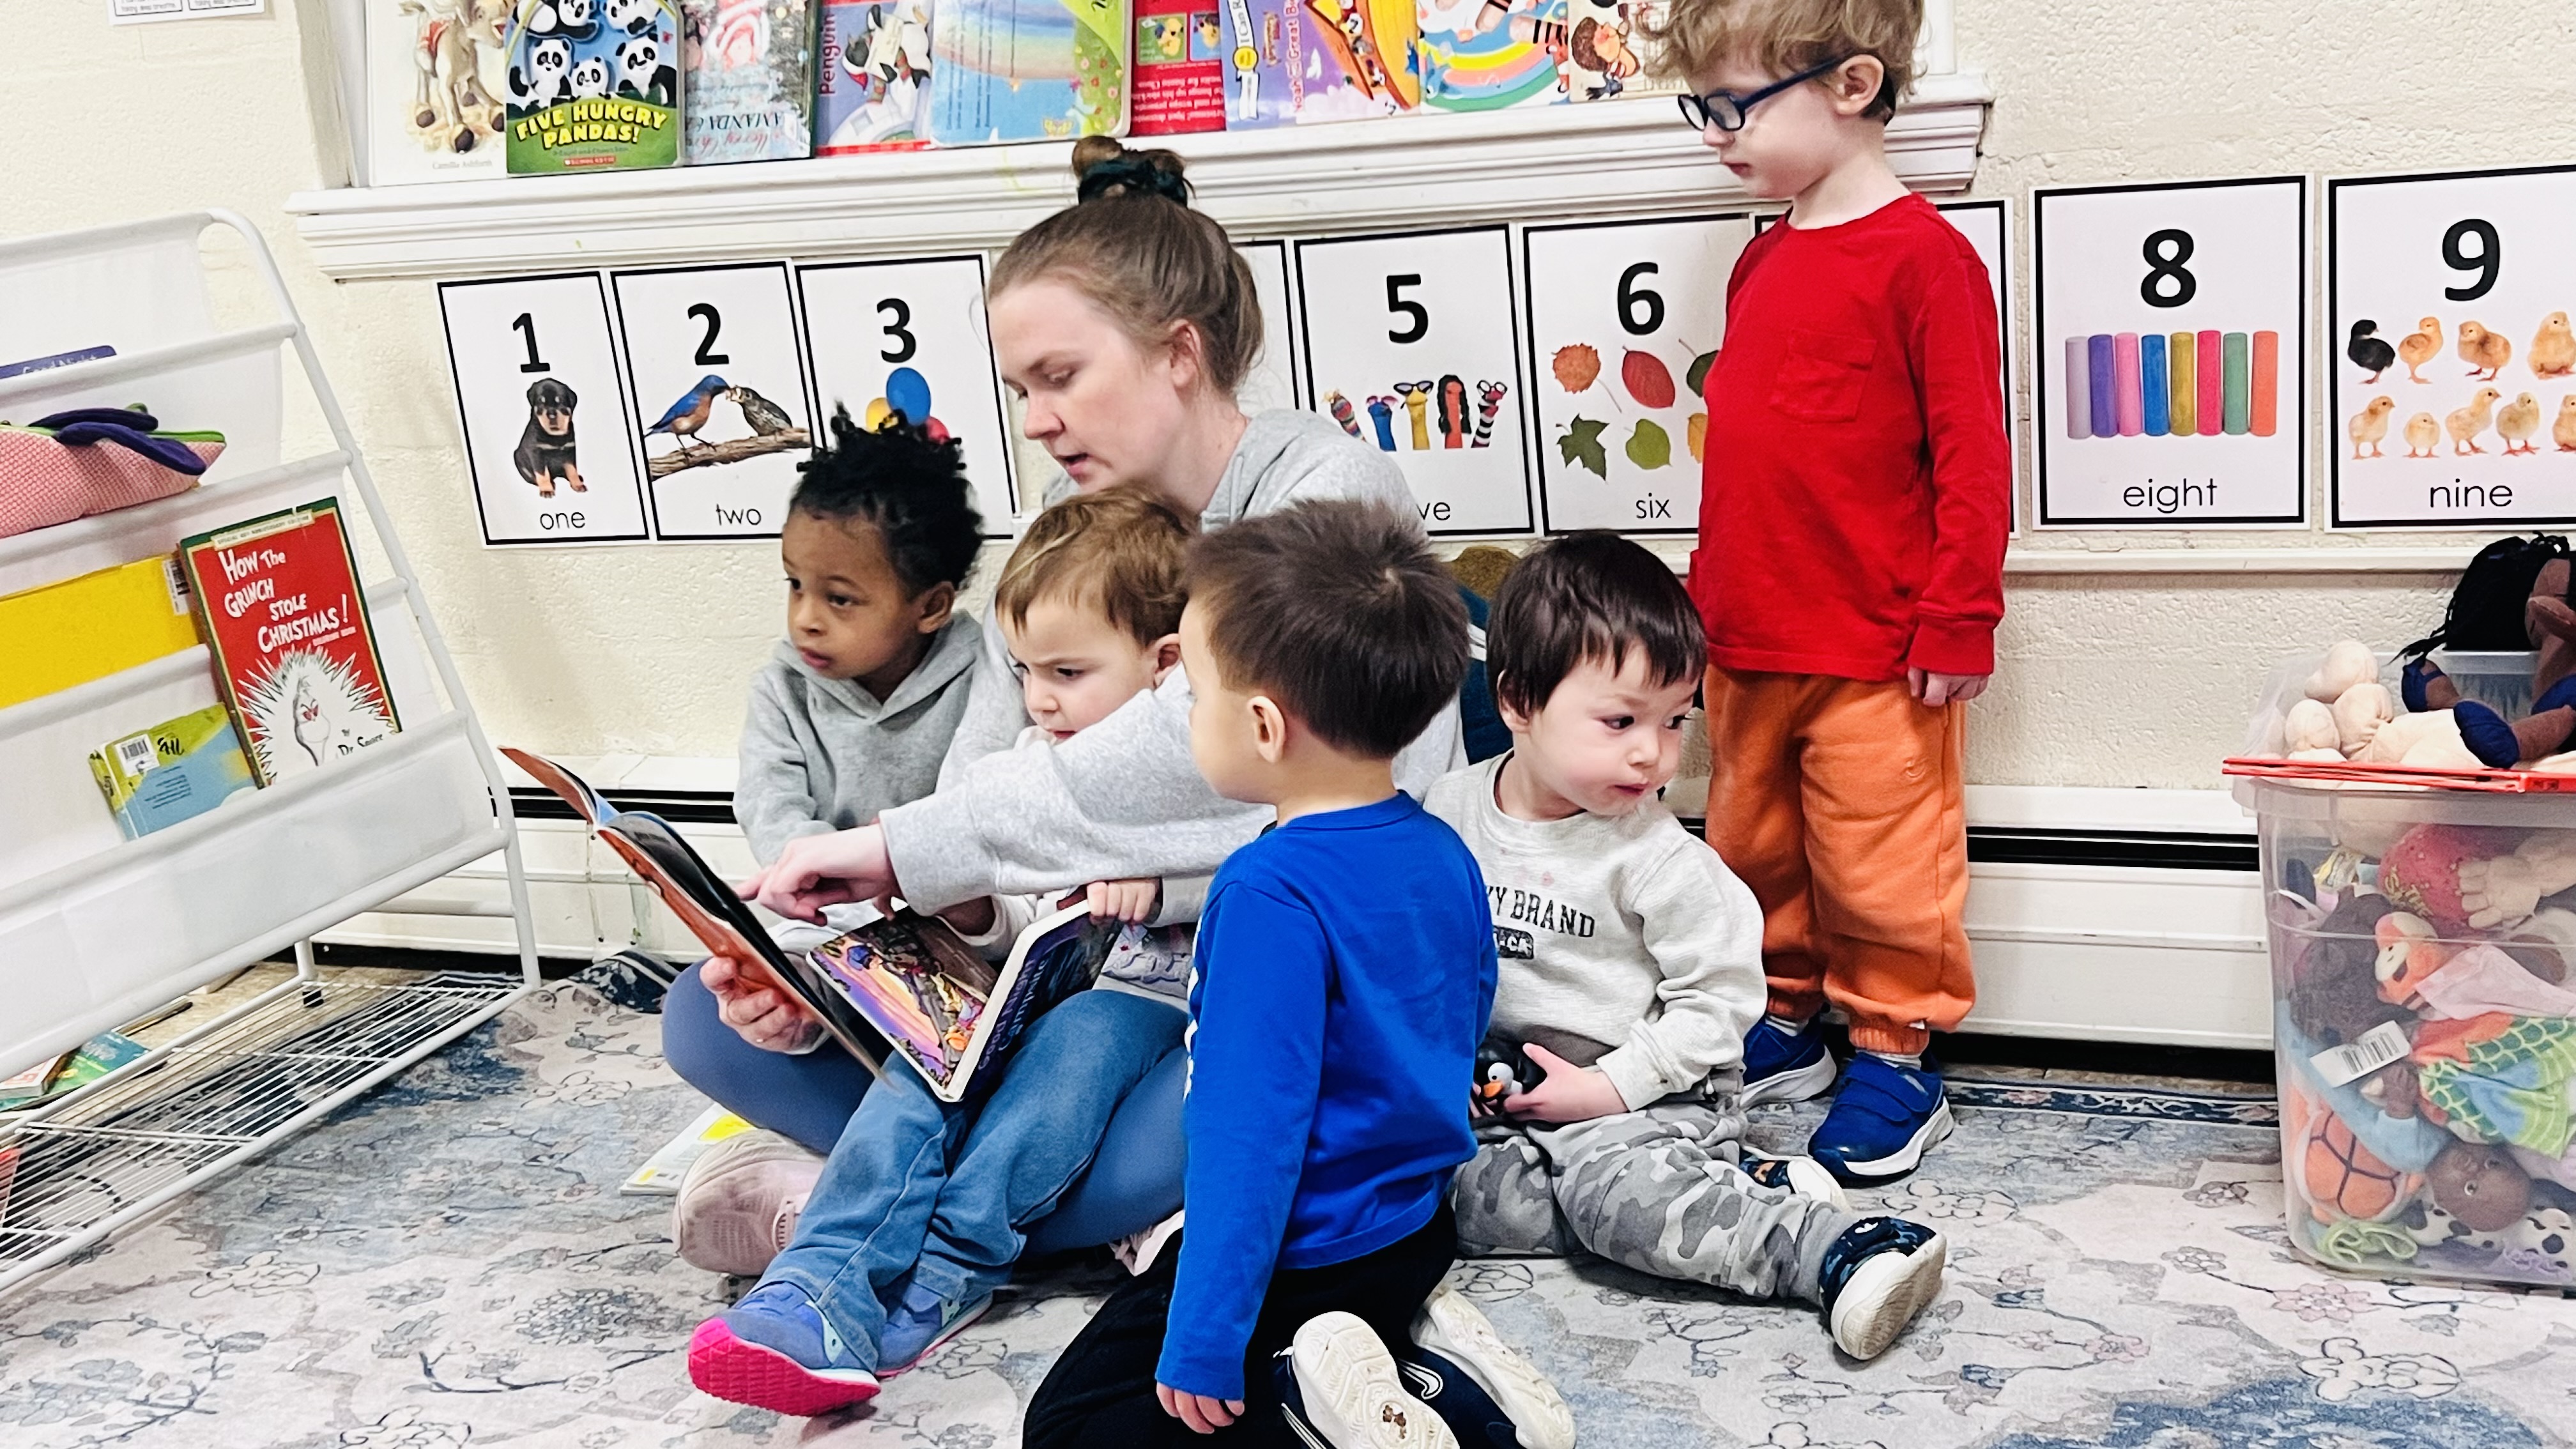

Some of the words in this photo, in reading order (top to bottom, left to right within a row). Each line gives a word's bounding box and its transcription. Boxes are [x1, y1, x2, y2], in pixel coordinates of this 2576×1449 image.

[818, 13, 841, 95] Penguin
[1288, 20, 1300, 59] Great
[516, 109, 565, 141] FIVE
[572, 103, 667, 130] HUNGRY
[543, 124, 640, 150] PANDAS!
[2140, 229, 2196, 308] 8
[2442, 218, 2501, 302] 9
[1386, 273, 1429, 344] 5
[1617, 262, 1665, 335] 6
[512, 312, 551, 373] 1
[687, 303, 729, 365] 2
[875, 298, 917, 363] 3
[1416, 502, 1451, 521] ve
[1635, 492, 1672, 520] six
[2122, 478, 2218, 514] eight
[2430, 477, 2513, 509] nine
[539, 510, 586, 531] one
[716, 503, 762, 528] two
[259, 549, 287, 569] The
[224, 578, 275, 618] GRINCH
[269, 593, 307, 622] STOLE
[1510, 889, 1595, 937] BRAND
[978, 1020, 1007, 1071] Good
[1001, 959, 1036, 1017] Night
[998, 960, 1048, 1051] Campsite
